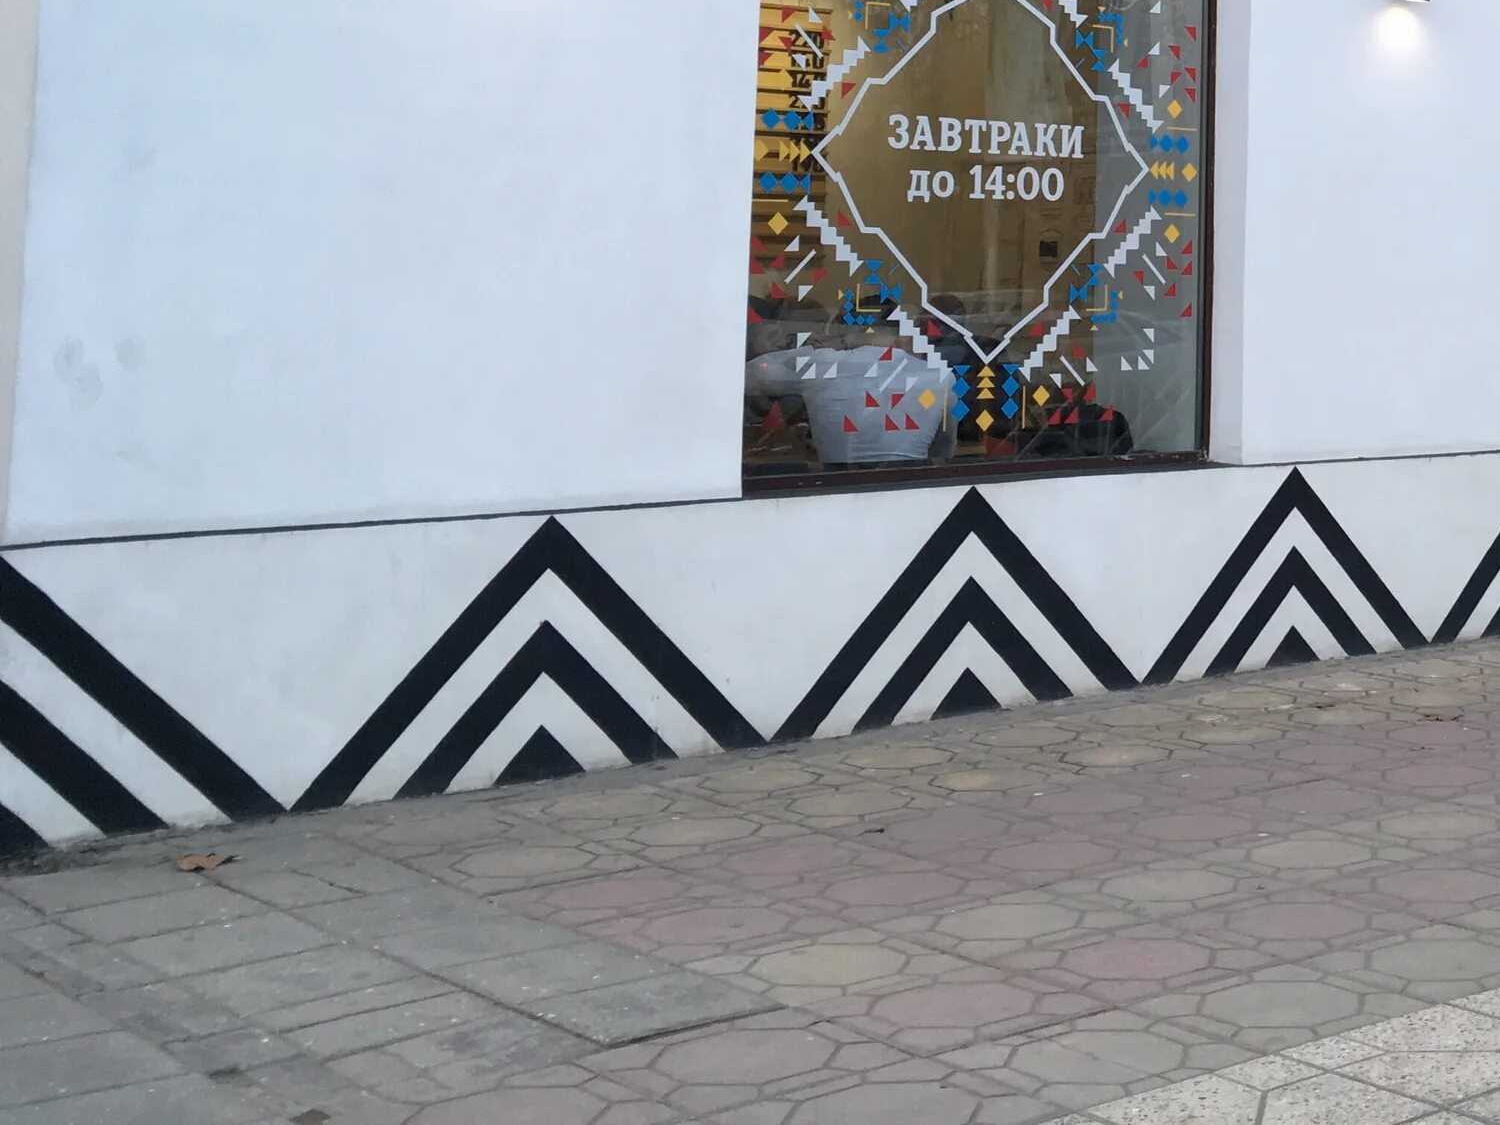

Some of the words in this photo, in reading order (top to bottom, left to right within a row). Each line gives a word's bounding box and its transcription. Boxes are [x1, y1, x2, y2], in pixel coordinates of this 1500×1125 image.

[887, 114, 1085, 159] ЗАВТРАКИ
[907, 169, 955, 203] до
[969, 164, 1065, 202] 14:00
